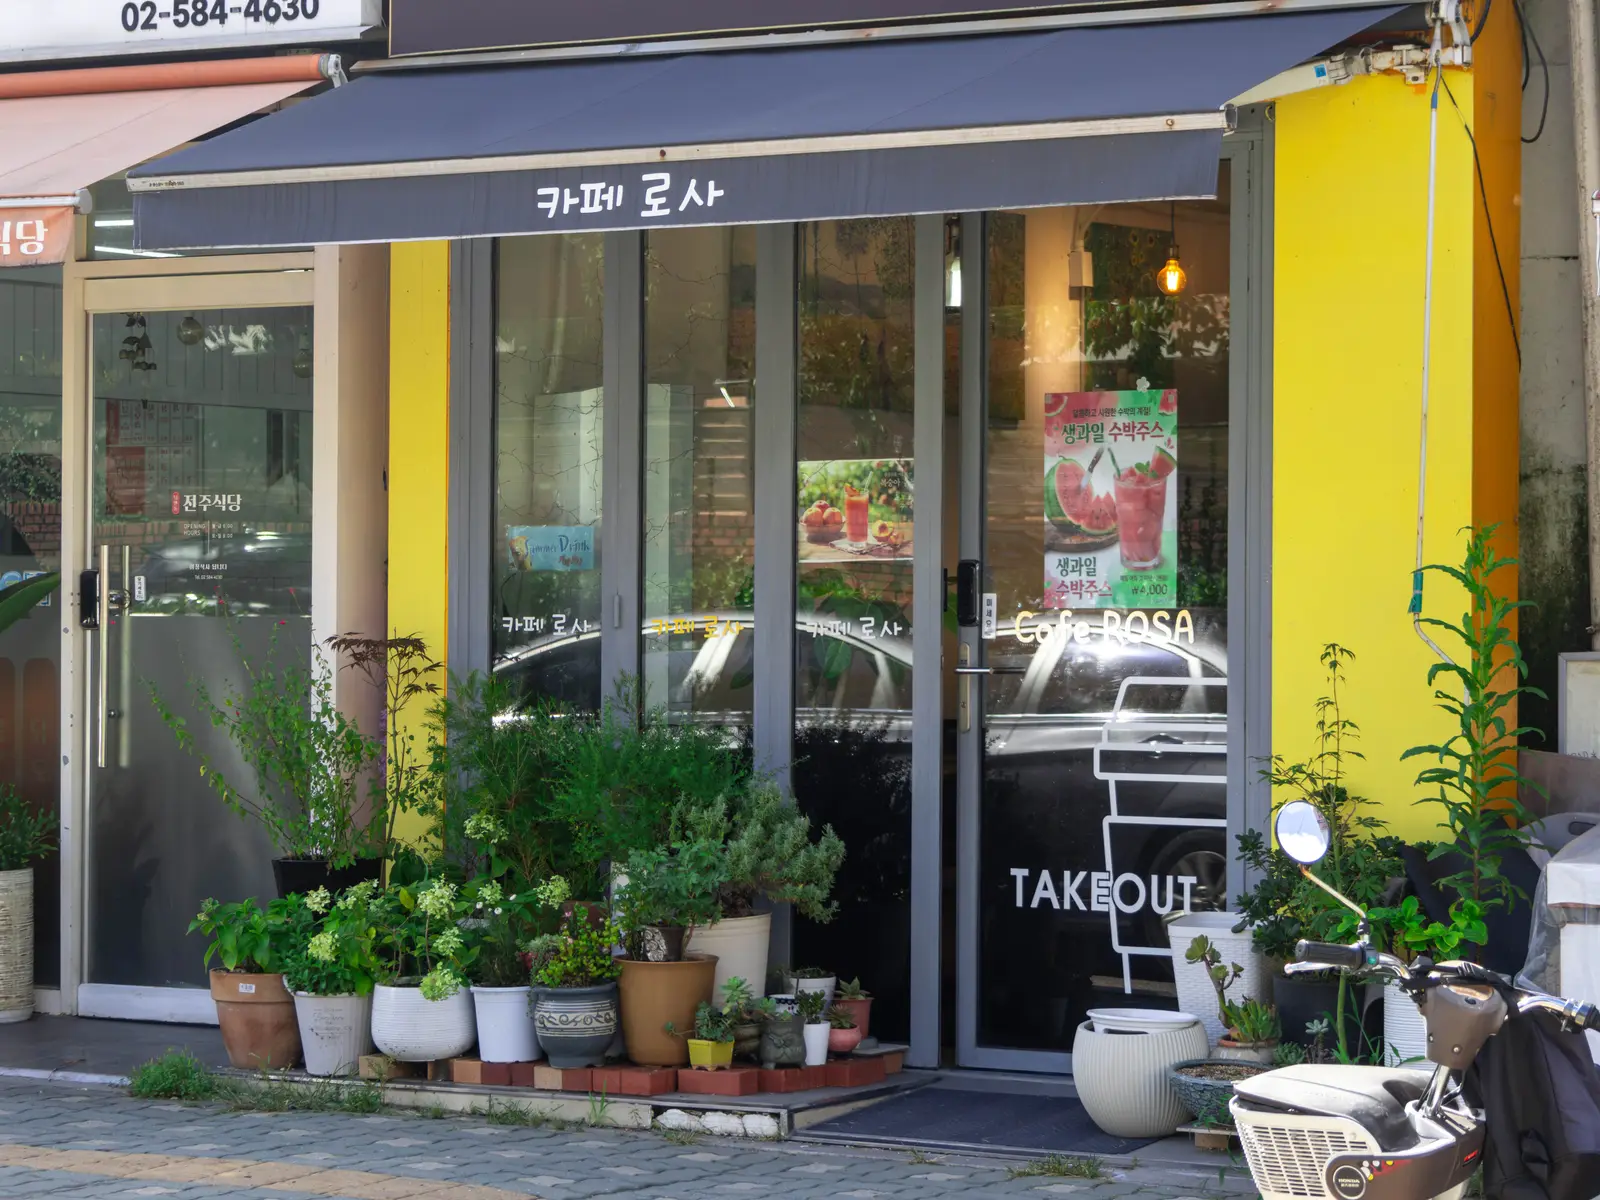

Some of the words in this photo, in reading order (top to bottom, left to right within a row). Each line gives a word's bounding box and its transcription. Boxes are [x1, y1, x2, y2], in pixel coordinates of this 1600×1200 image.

[121, 0, 320, 32] 02-584-4630
[537, 182, 624, 218] 카페
[640, 172, 725, 217] 로사
[1061, 422, 1104, 445] 생과일
[1108, 420, 1164, 443] 수박주스
[183, 494, 242, 512] 전주식당
[558, 534, 590, 553] Drink
[1056, 556, 1097, 577] 생과일
[1056, 580, 1112, 600] 수박주스
[502, 616, 544, 632] 카페
[552, 614, 592, 635] 로사
[650, 618, 694, 635] 카페
[703, 615, 744, 638] 로사
[806, 620, 851, 638] 카페
[859, 616, 902, 639] 로사
[1015, 610, 1091, 645] Cafe
[1103, 609, 1195, 646] ROSA
